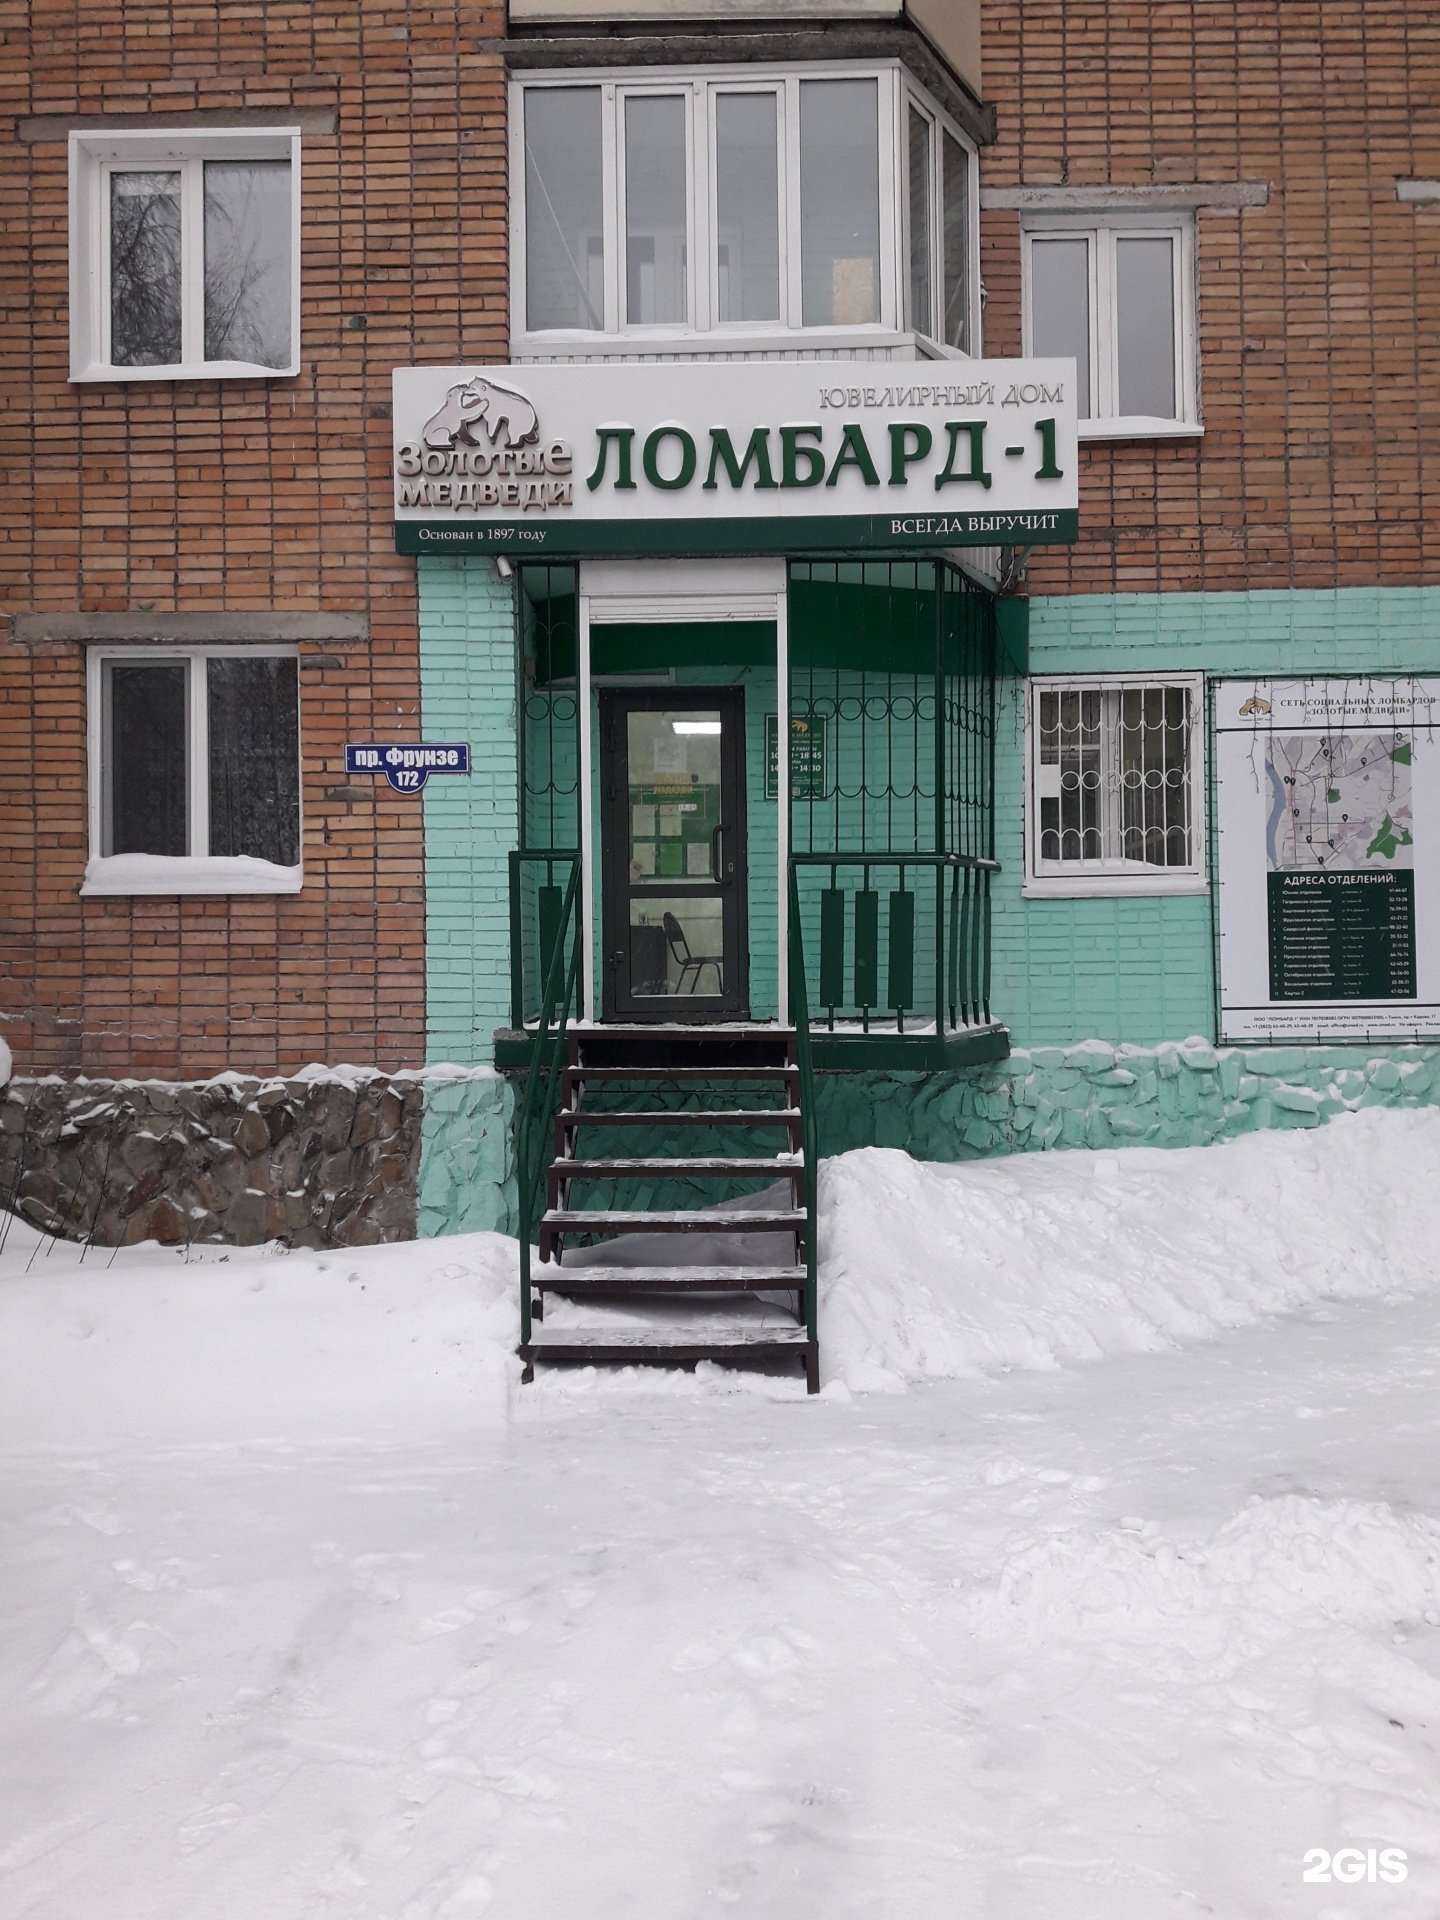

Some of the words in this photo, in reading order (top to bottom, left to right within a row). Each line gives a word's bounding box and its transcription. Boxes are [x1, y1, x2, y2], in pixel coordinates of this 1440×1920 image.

[819, 380, 995, 409] ЮВЕЛИРНЫЙ
[1001, 383, 1064, 408] ДОМ
[890, 518, 963, 536] ВСЕГДА
[968, 514, 1059, 533] ВЫРУЧИТ
[418, 528, 474, 541] Основан
[477, 531, 484, 540] в
[487, 528, 515, 541] 1897
[517, 530, 547, 543] году
[1280, 698, 1305, 707] СЕТЬ
[1307, 697, 1376, 707] СОЦИАЛЬНЫХ
[1378, 696, 1436, 706] ЛОМБАРДОВ
[355, 750, 383, 768] пр.
[385, 747, 459, 768] Фрунзе
[396, 771, 419, 787] 172
[1284, 876, 1326, 886] АДРЕСА
[1328, 873, 1397, 885] ОТДЕЛЕНИЙ:
